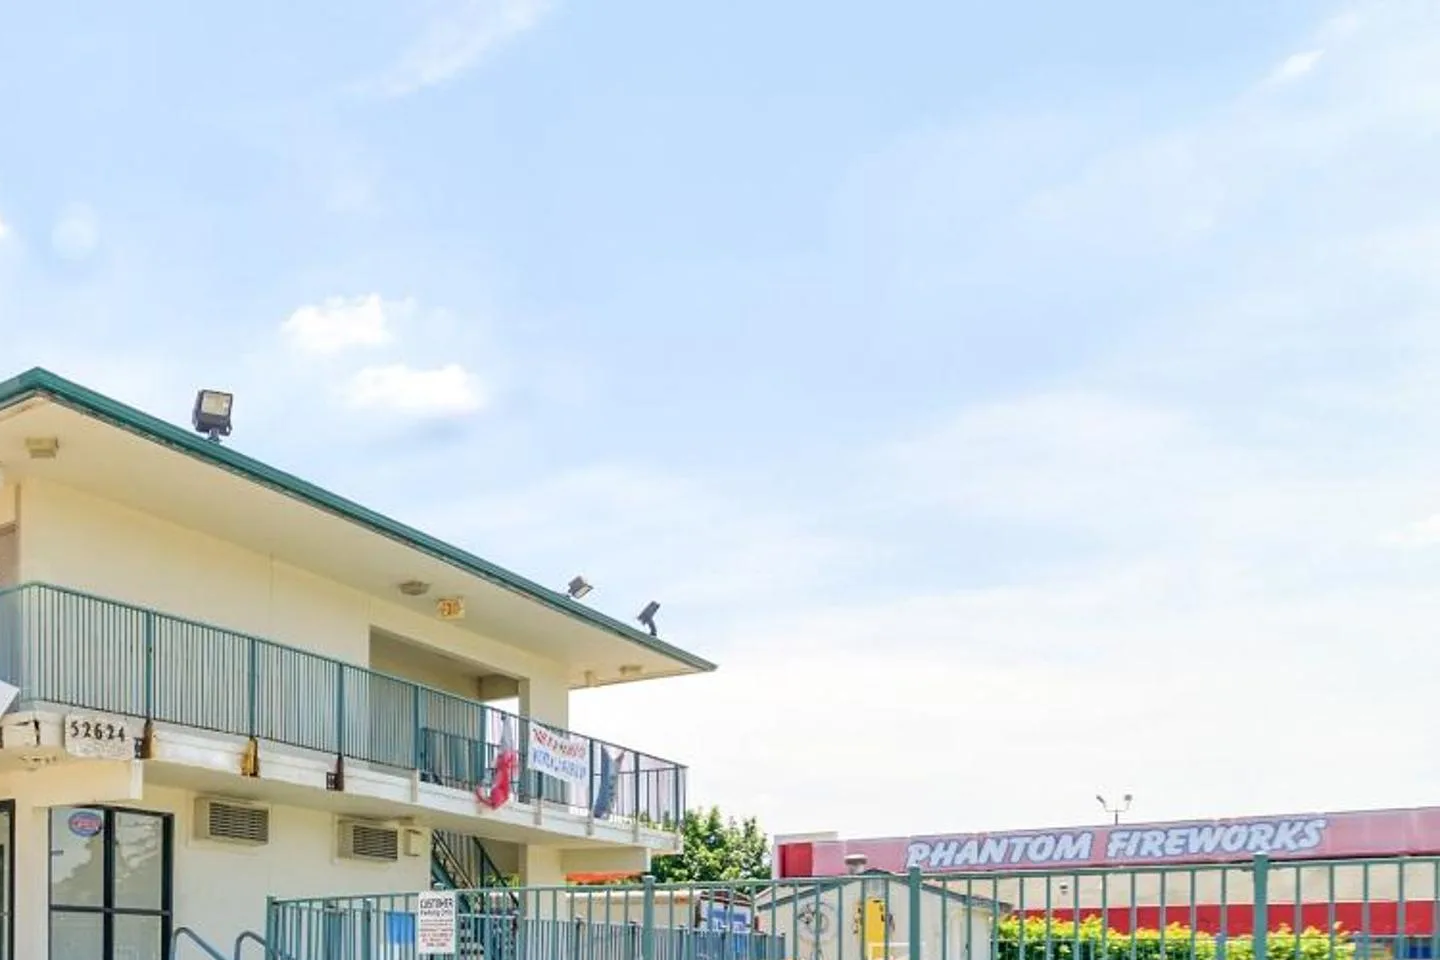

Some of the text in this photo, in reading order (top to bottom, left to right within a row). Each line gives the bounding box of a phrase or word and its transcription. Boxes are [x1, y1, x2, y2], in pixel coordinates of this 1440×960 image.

[70, 720, 125, 742] 52624
[903, 818, 1328, 868] PHANTOM FIREWORKS
